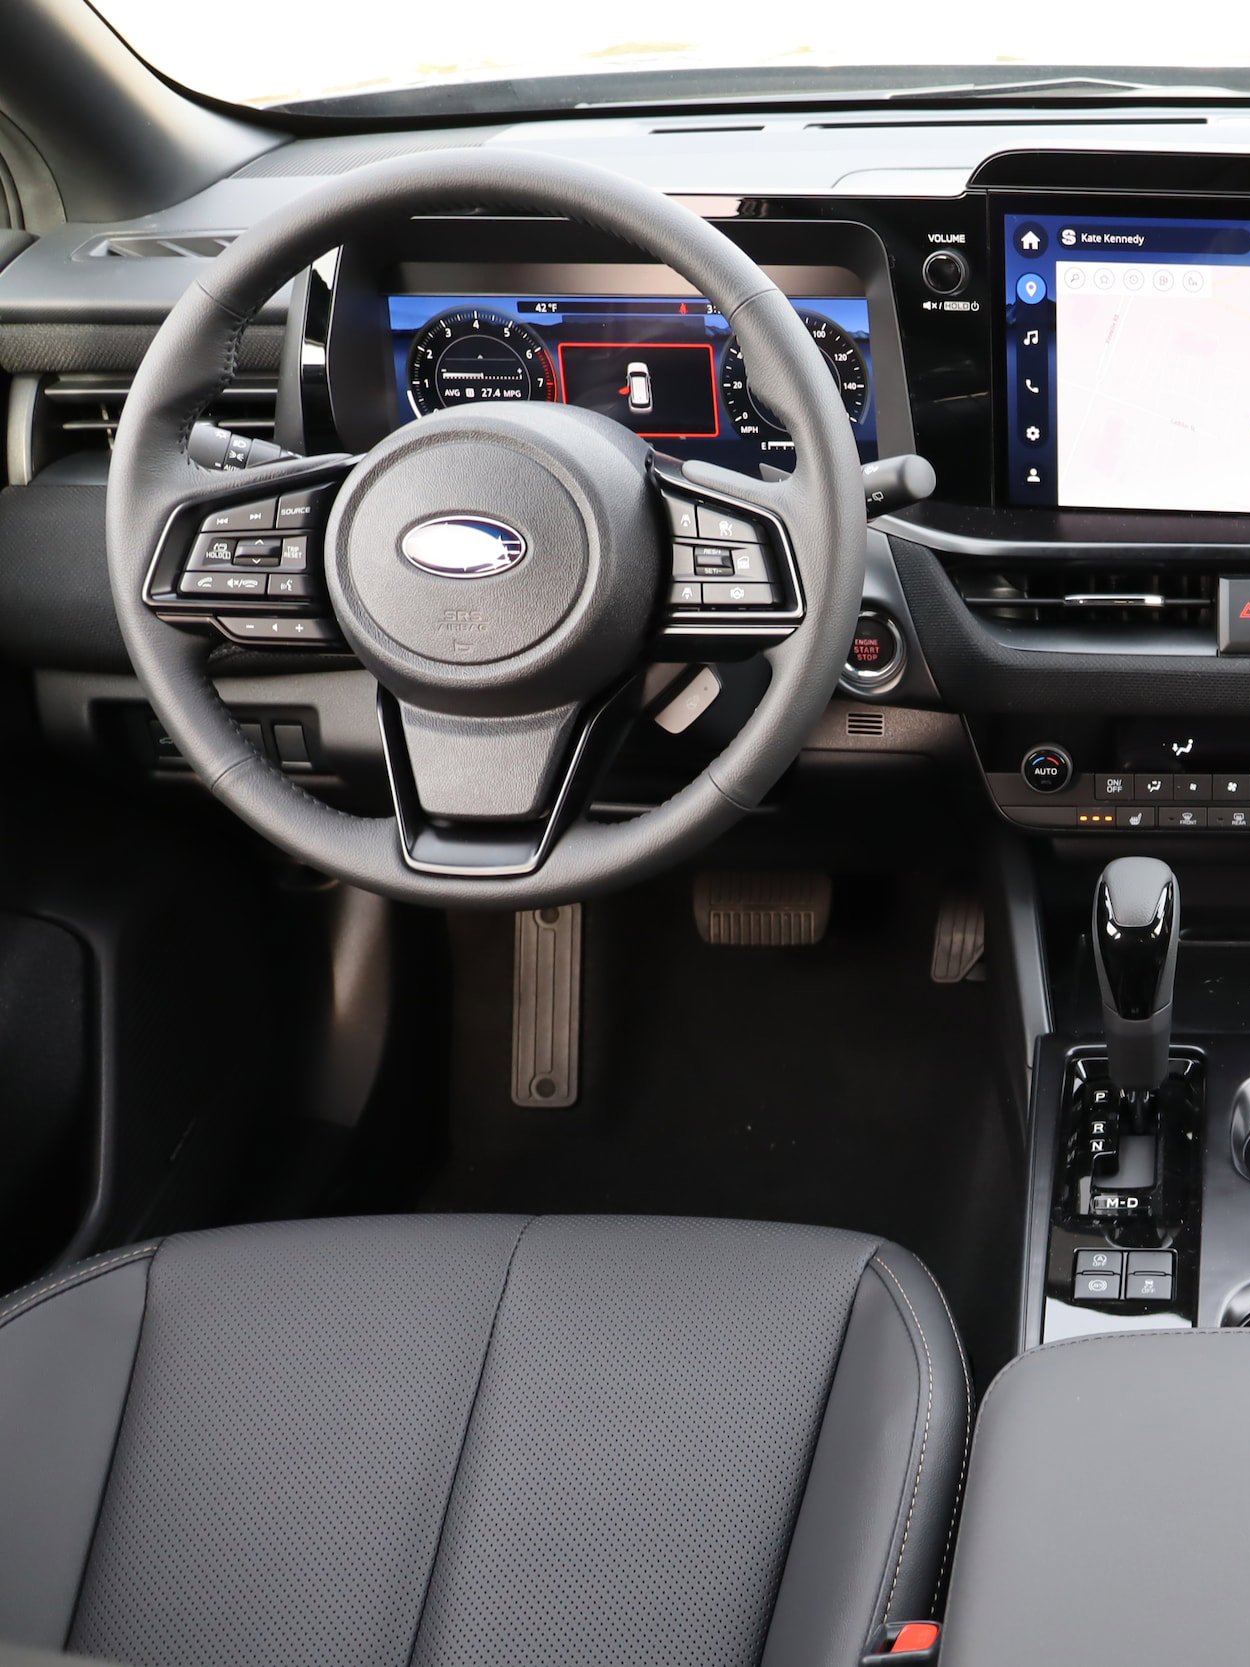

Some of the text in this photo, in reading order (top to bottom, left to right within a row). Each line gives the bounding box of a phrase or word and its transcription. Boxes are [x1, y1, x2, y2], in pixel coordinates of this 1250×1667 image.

[928, 234, 966, 243] VOLUME
[1081, 233, 1102, 243] Kate
[1104, 234, 1144, 247] Kennedy
[944, 302, 970, 310] HOLD
[473, 320, 480, 329] 4
[445, 328, 452, 338] 3
[504, 328, 511, 338] 5
[813, 330, 826, 338] 100
[426, 349, 433, 359] 2
[526, 349, 533, 359] 6
[424, 379, 429, 388] 1
[537, 378, 544, 387] 7
[733, 381, 742, 389] 20
[843, 382, 857, 390] 140
[444, 389, 460, 397] AVG
[481, 388, 501, 397] 27.4
[503, 389, 521, 398] MPG
[742, 412, 748, 420] 0
[761, 442, 767, 450] E
[281, 506, 311, 516] SOURCE
[443, 610, 483, 622] SRS
[438, 623, 488, 631] AIRBAG
[854, 646, 880, 654] START
[1034, 767, 1058, 776] AUTO
[1106, 785, 1122, 793] OFF
[1096, 1093, 1106, 1102] P
[1093, 1123, 1104, 1134] R
[1091, 1141, 1103, 1152] N
